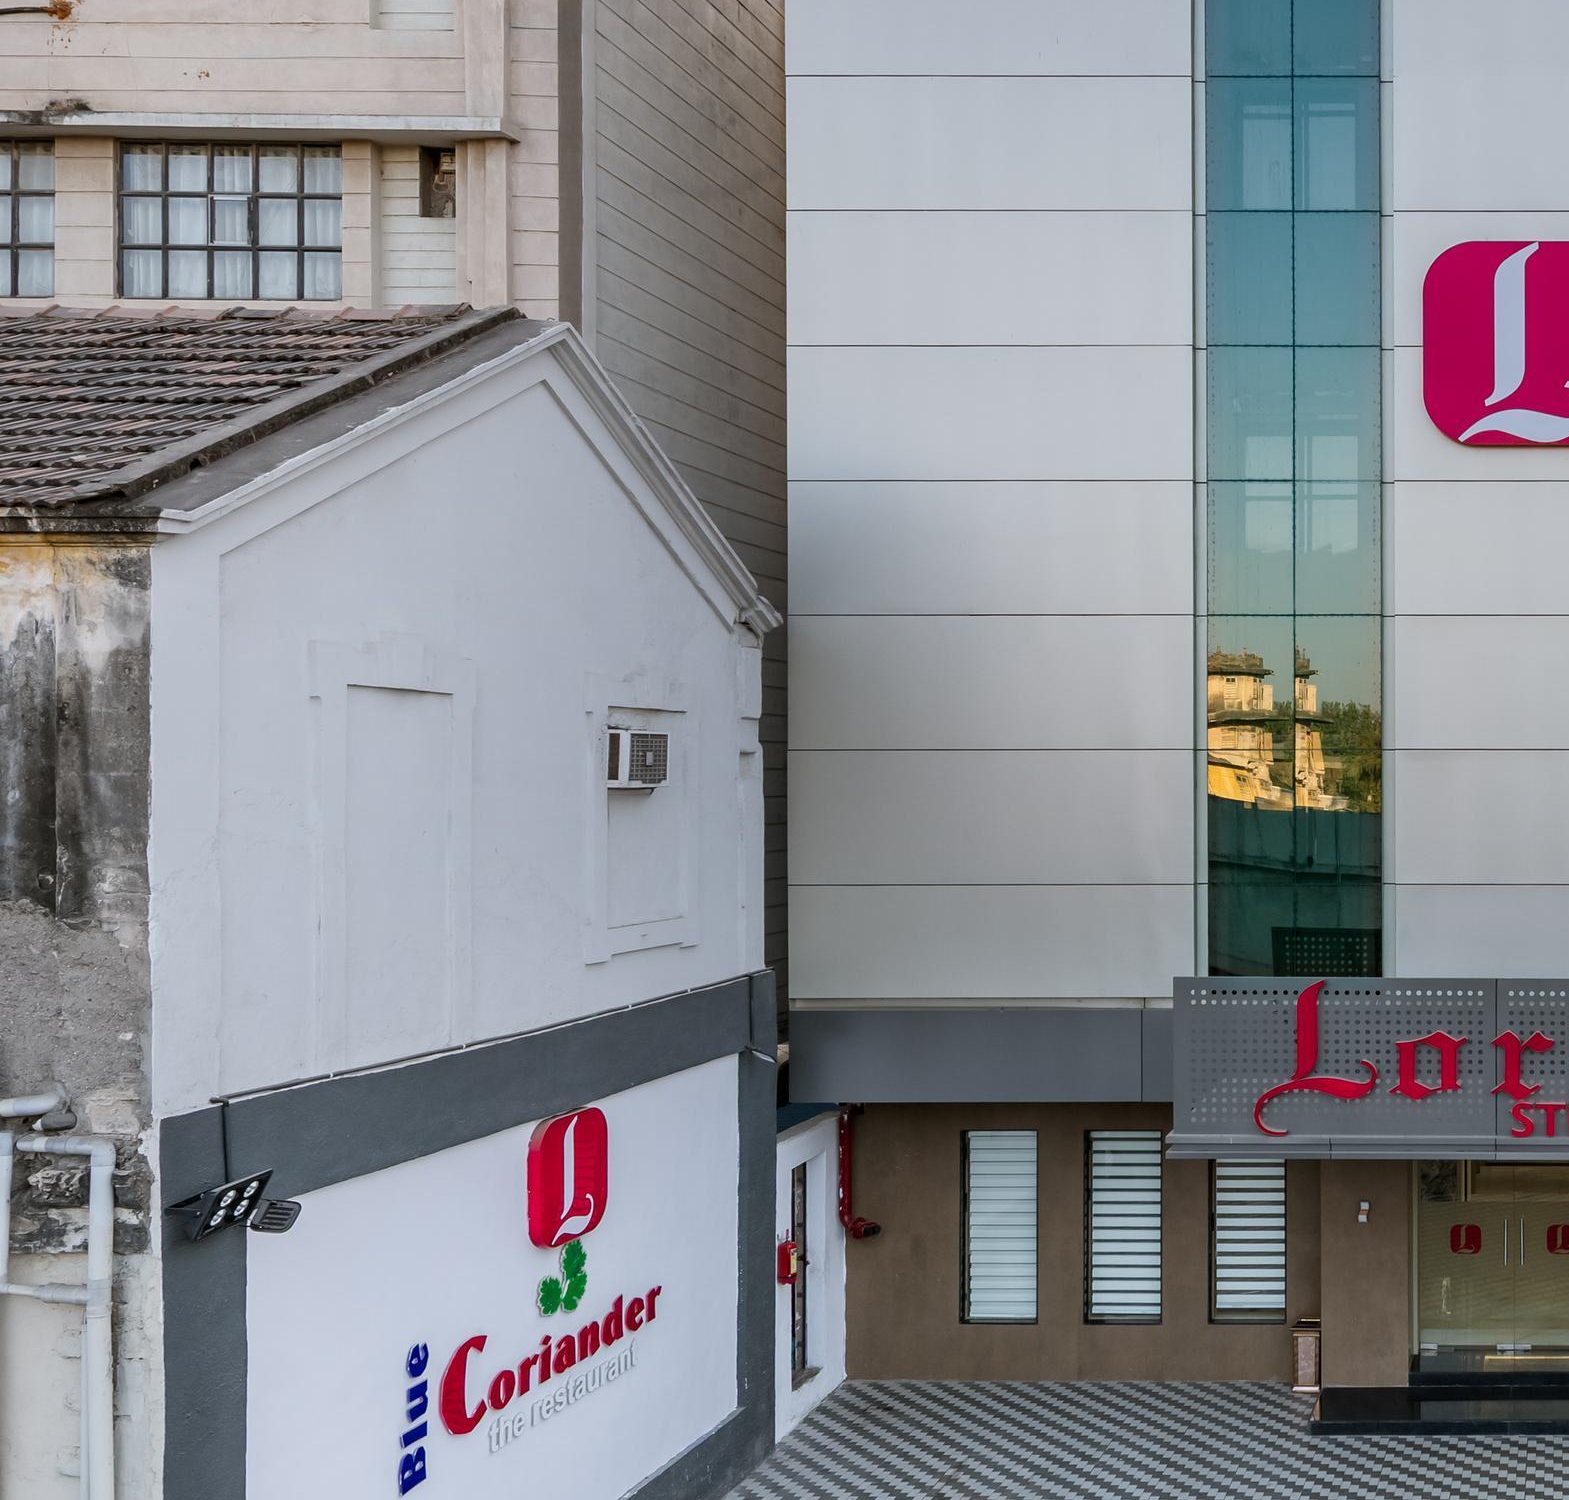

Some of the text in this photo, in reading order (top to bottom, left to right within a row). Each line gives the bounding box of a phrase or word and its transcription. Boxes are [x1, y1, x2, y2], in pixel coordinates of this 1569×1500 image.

[399, 1342, 429, 1497] Blue
[438, 1285, 662, 1436] Coriander
[488, 1337, 639, 1455] the restaurant
